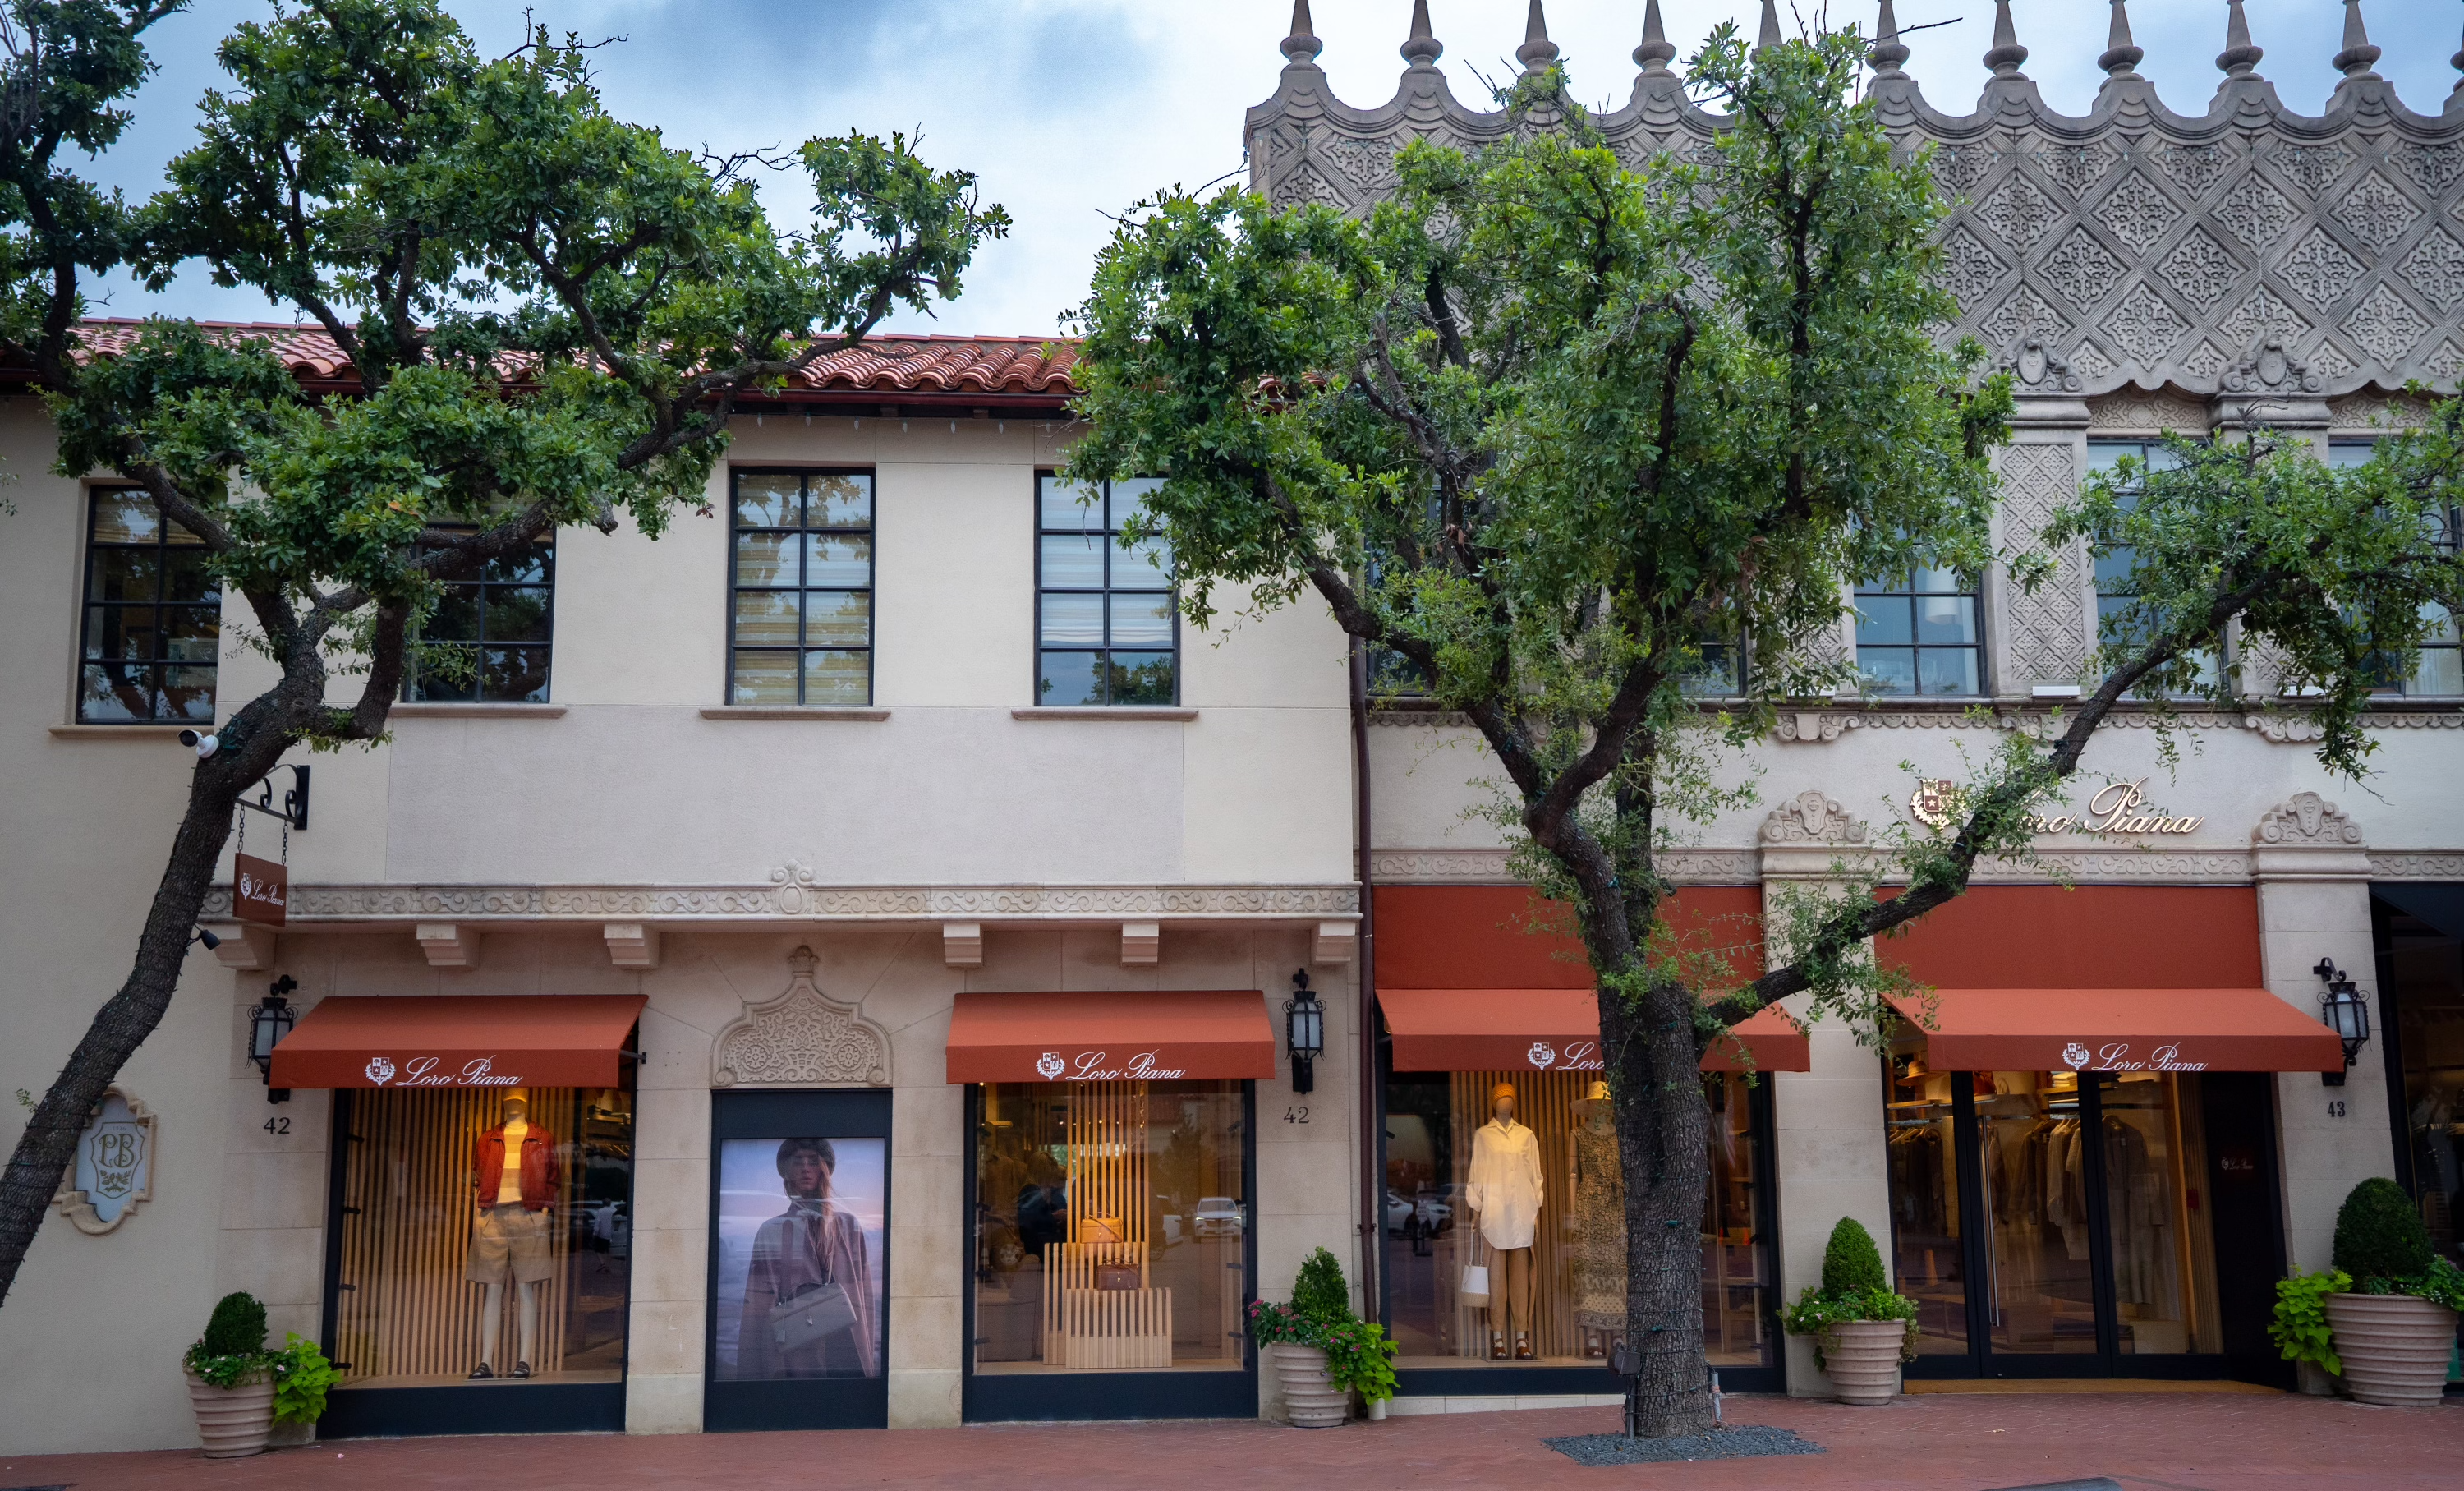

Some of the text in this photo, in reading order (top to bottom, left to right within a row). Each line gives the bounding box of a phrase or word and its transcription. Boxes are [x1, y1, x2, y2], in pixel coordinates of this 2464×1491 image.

[2084, 775, 2205, 833] Piana
[251, 878, 268, 902] Loro
[1065, 1048, 1186, 1080] Loro Piana
[2091, 1041, 2209, 1072] Loro Piana
[395, 1055, 523, 1086] Loro Piana
[1283, 1106, 1310, 1124] 42
[2328, 1101, 2346, 1117] 43
[263, 1116, 291, 1134] 42
